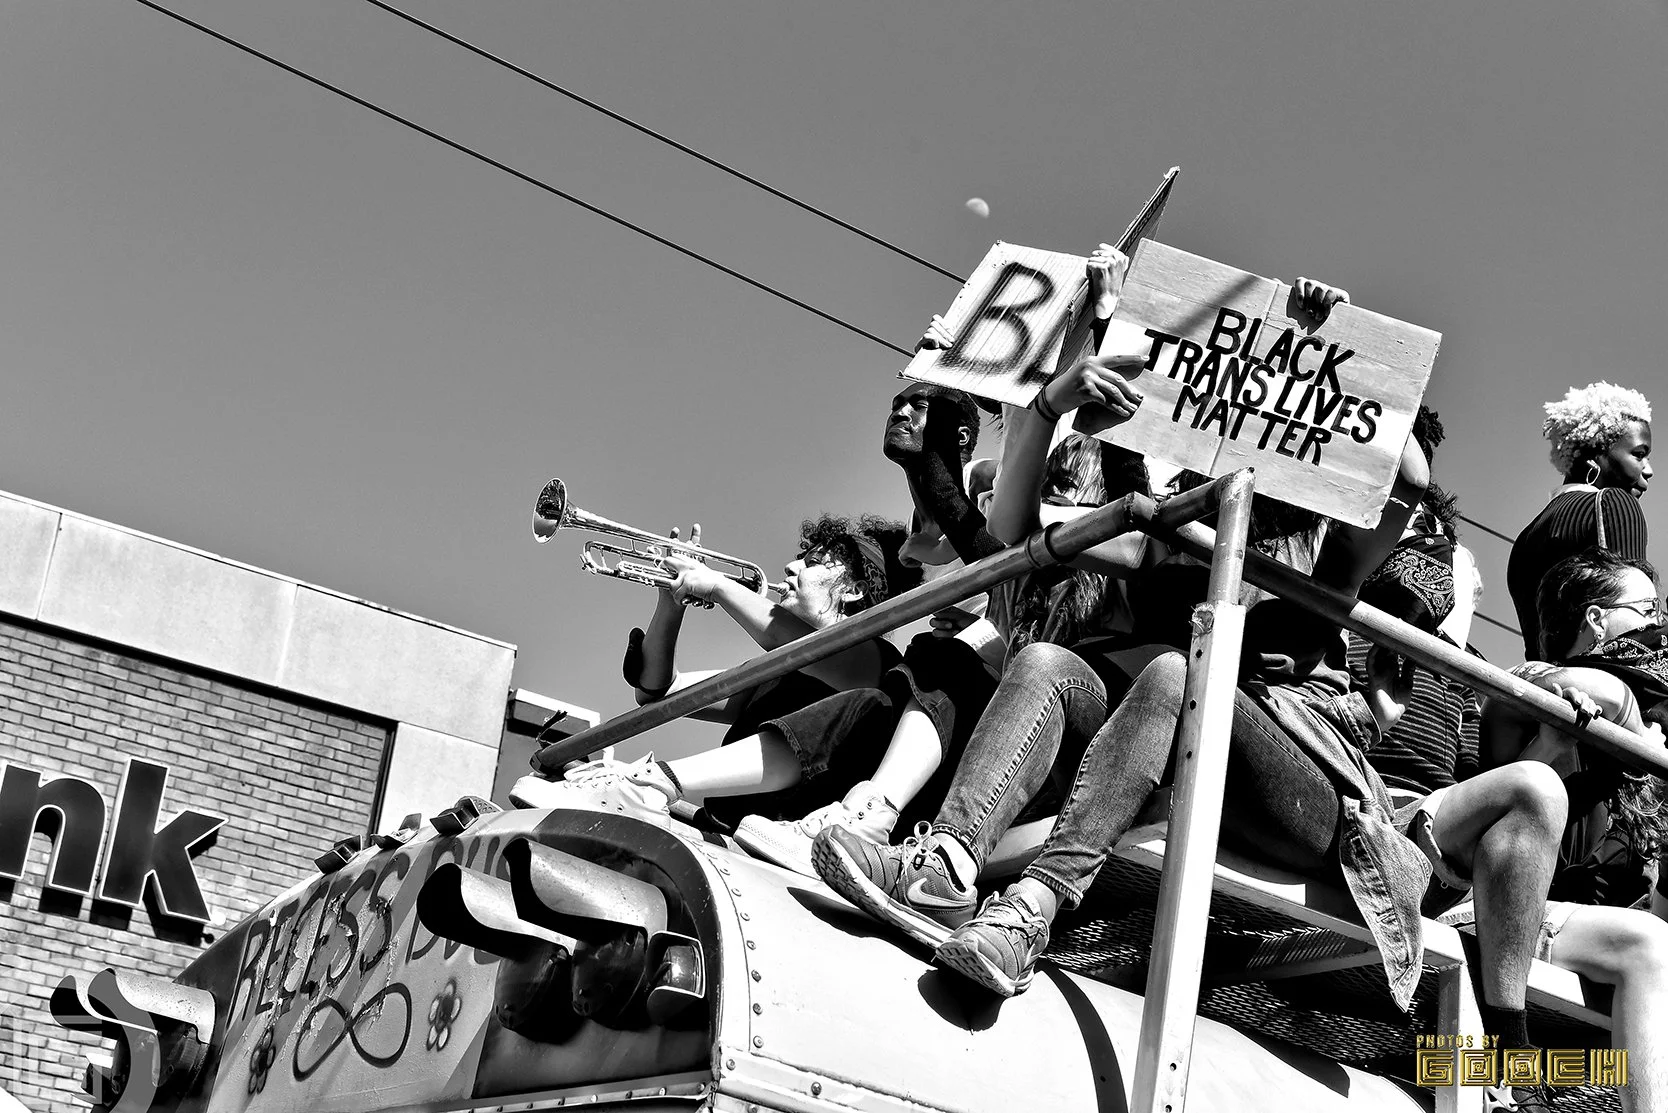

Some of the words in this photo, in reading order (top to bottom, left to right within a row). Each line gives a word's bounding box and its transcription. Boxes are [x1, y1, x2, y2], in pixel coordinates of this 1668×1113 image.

[1144, 328, 1276, 407] TRANS
[1274, 376, 1382, 444] LIVES
[1206, 307, 1355, 393] BLACK
[1172, 384, 1332, 466] MATTER
